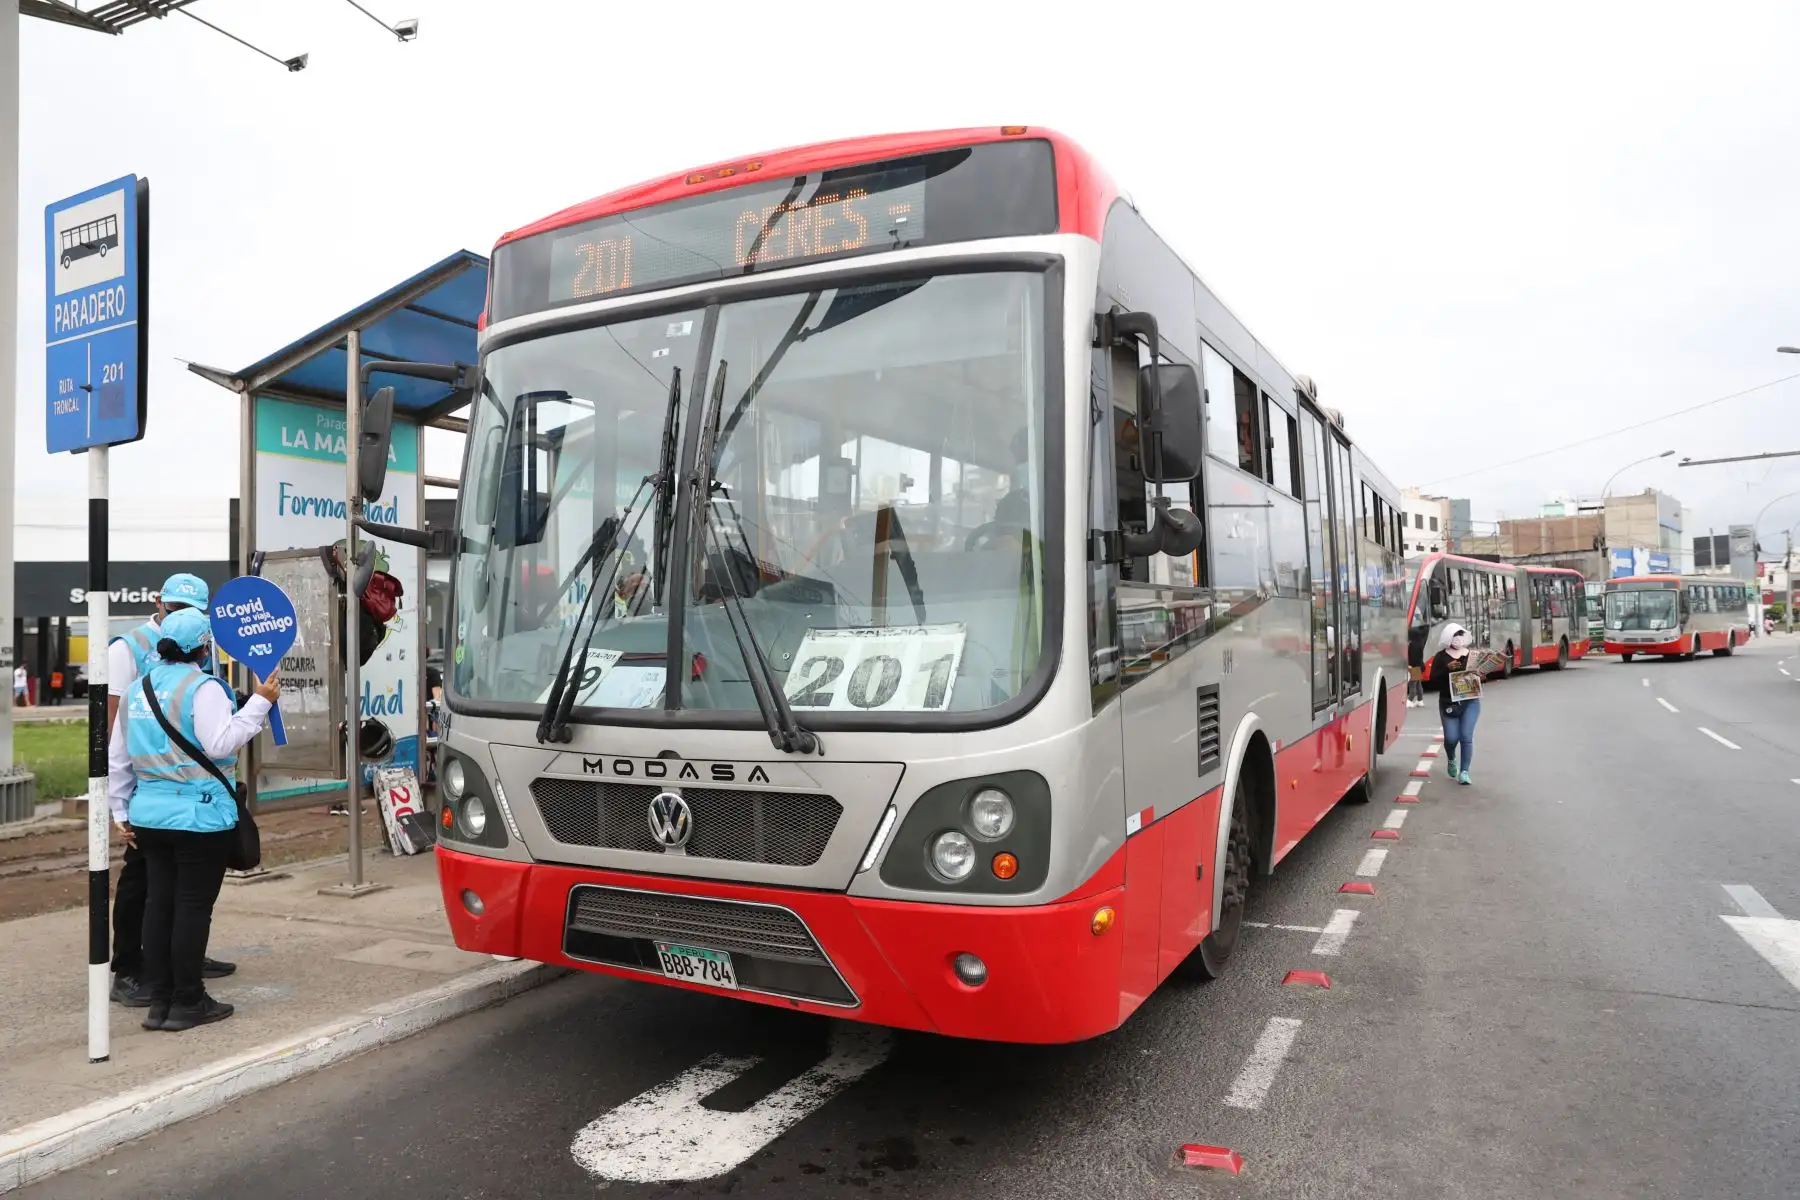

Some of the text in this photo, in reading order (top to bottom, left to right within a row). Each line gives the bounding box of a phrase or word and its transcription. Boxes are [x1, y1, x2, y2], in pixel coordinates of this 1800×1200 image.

[573, 235, 632, 299] 201
[735, 188, 868, 266] CERES
[54, 284, 125, 334] PARADERO
[102, 361, 124, 384] 201
[59, 378, 73, 395] RUTA
[53, 398, 80, 416] TRONCAL
[316, 413, 348, 431] Para
[281, 427, 309, 450] LA
[215, 597, 264, 619] El Covid
[240, 611, 271, 624] no viaja
[238, 616, 293, 637] conmigo
[248, 642, 272, 656] ATU
[787, 653, 955, 709] 201
[582, 757, 770, 784] MODASA
[660, 952, 732, 984] BBB-784
